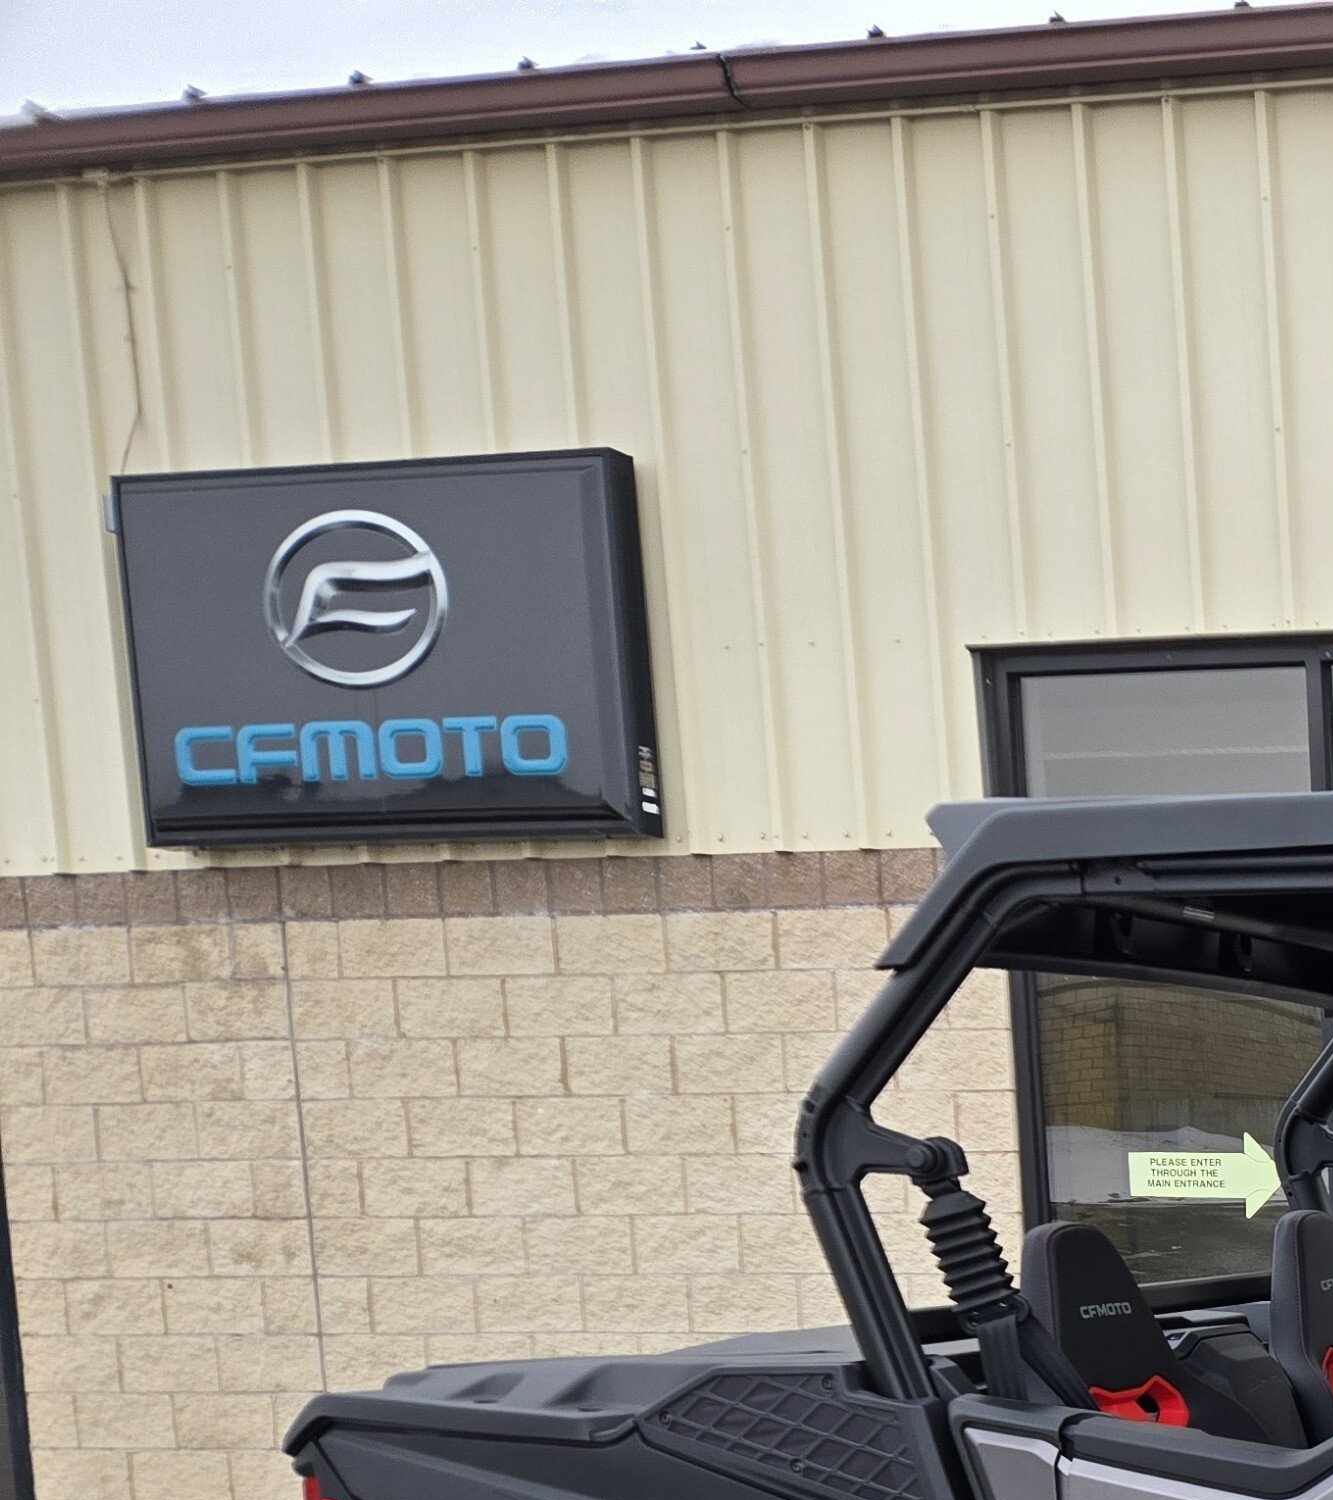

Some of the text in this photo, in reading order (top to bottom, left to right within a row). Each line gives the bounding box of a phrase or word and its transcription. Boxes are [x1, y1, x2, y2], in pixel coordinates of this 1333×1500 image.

[175, 714, 567, 785] CFMOTO
[1149, 1157, 1222, 1167] PLEASE ENTER
[1150, 1168, 1219, 1178] THROUGH THE
[1147, 1179, 1226, 1189] MAIN ENTRANCE
[1079, 1301, 1132, 1320] CFMOTO
